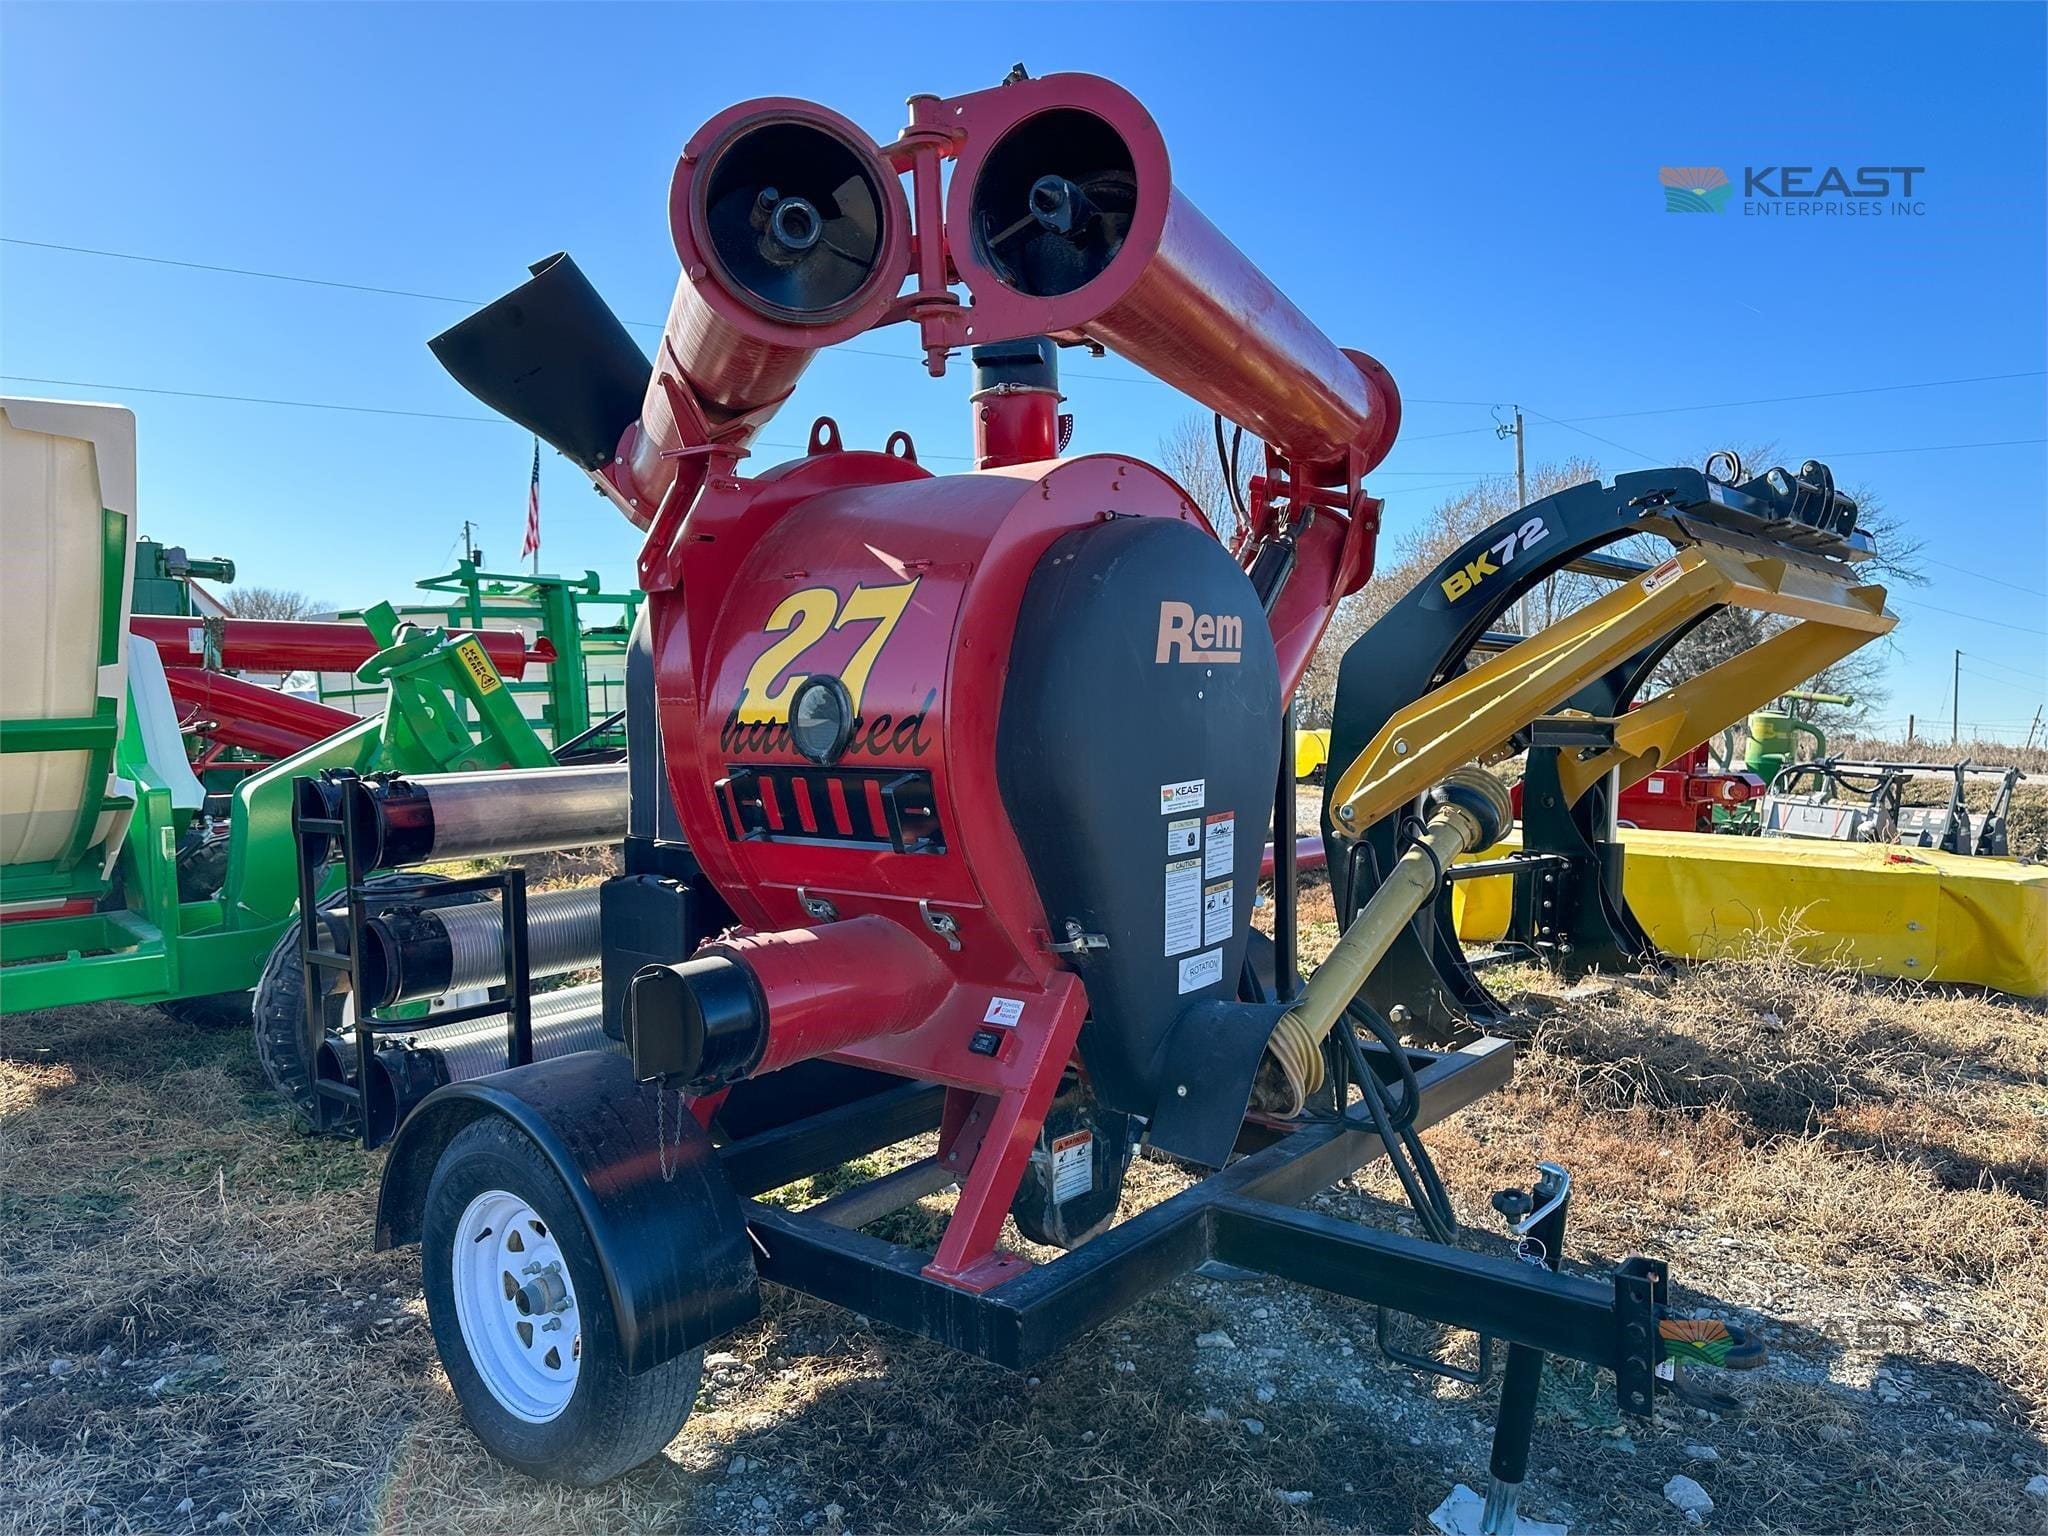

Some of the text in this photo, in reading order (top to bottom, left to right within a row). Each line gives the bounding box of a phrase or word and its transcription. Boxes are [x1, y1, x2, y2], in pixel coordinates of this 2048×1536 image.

[1441, 517, 1550, 603] BK72
[1155, 601, 1243, 664] Rem
[461, 646, 482, 677] CLEAR
[469, 648, 487, 674] KEEP
[737, 574, 924, 725] 27
[1175, 784, 1204, 796] KEAST
[1175, 860, 1197, 870] CAUTION
[1190, 960, 1218, 977] ROTATION
[1064, 1133, 1090, 1147] WARNING
